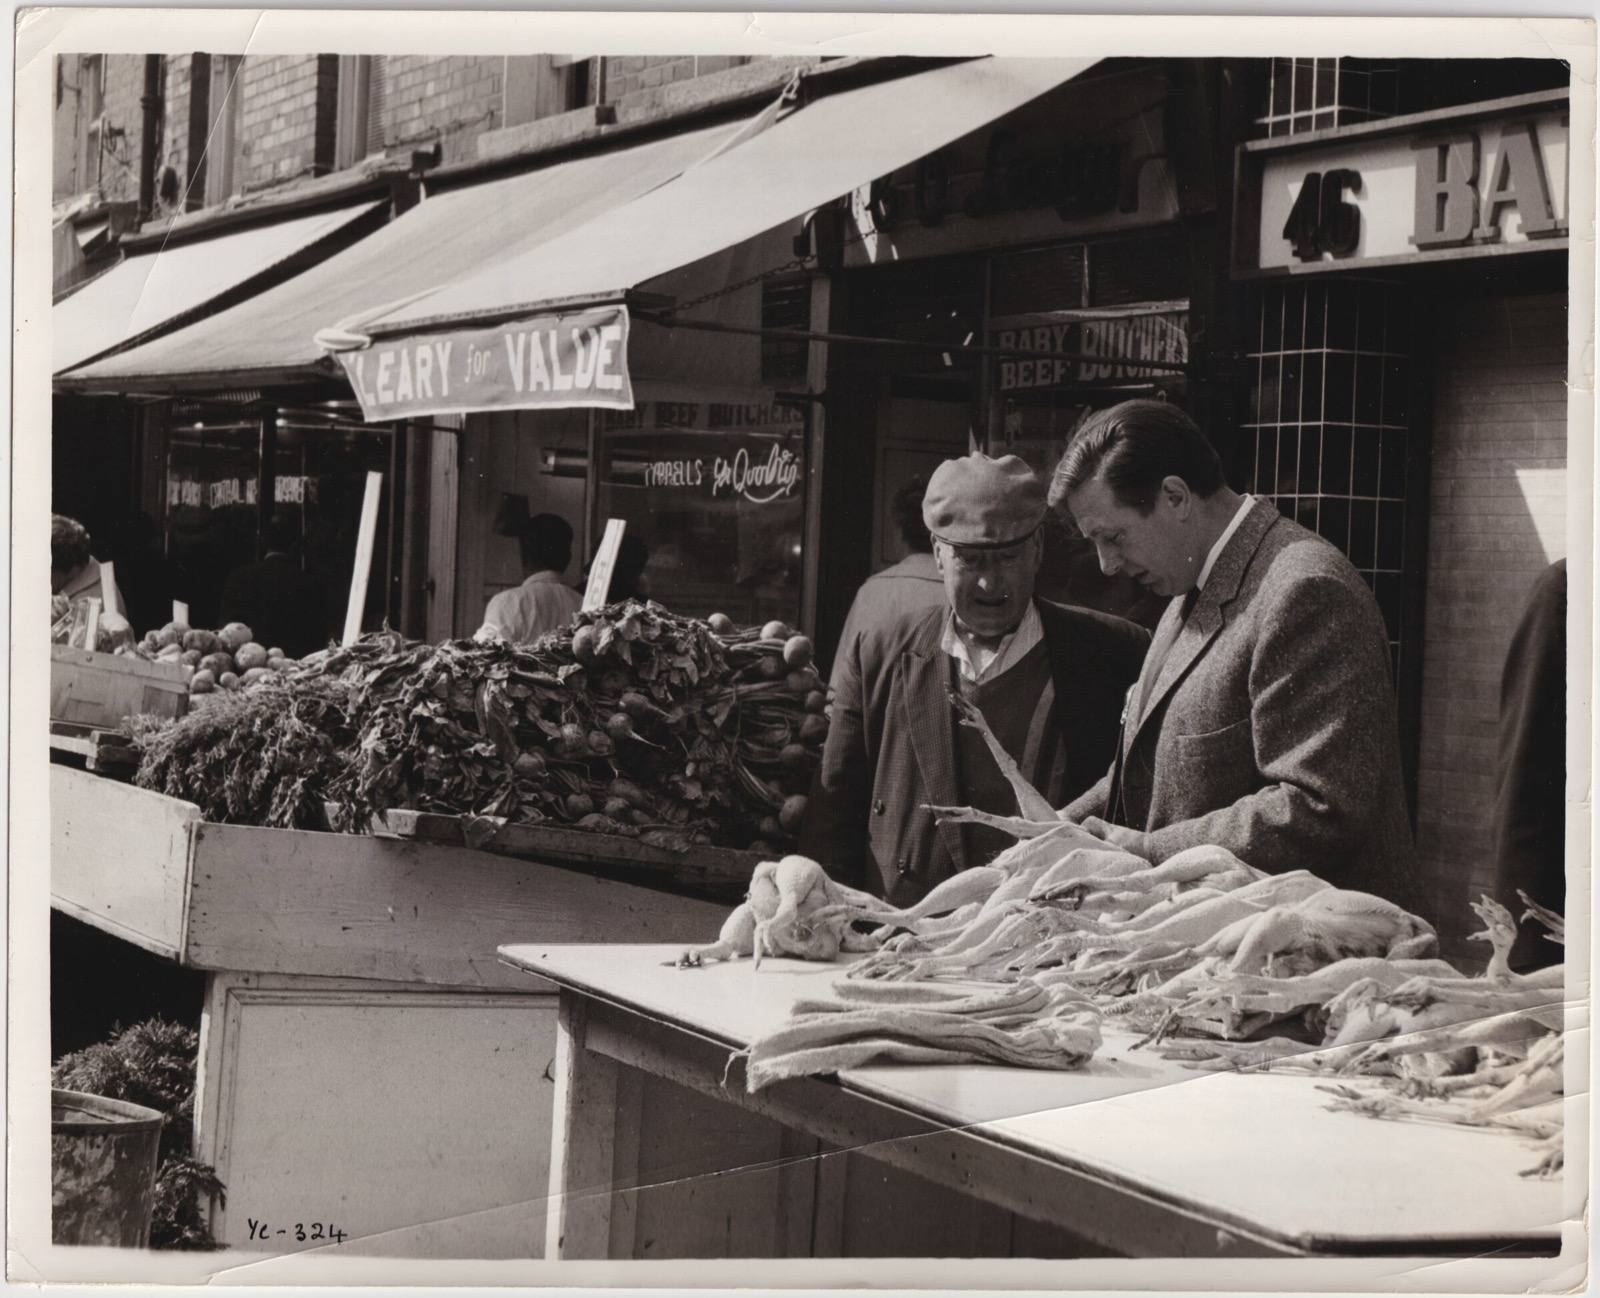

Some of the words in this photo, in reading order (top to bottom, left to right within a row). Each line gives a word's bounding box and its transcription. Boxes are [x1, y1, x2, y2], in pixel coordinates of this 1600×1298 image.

[1283, 168, 1363, 263] 46
[1408, 114, 1569, 246] BA
[464, 342, 492, 383] for
[505, 325, 623, 392] VALUE
[1000, 324, 1070, 353] BABY
[1000, 358, 1071, 391] BEEF
